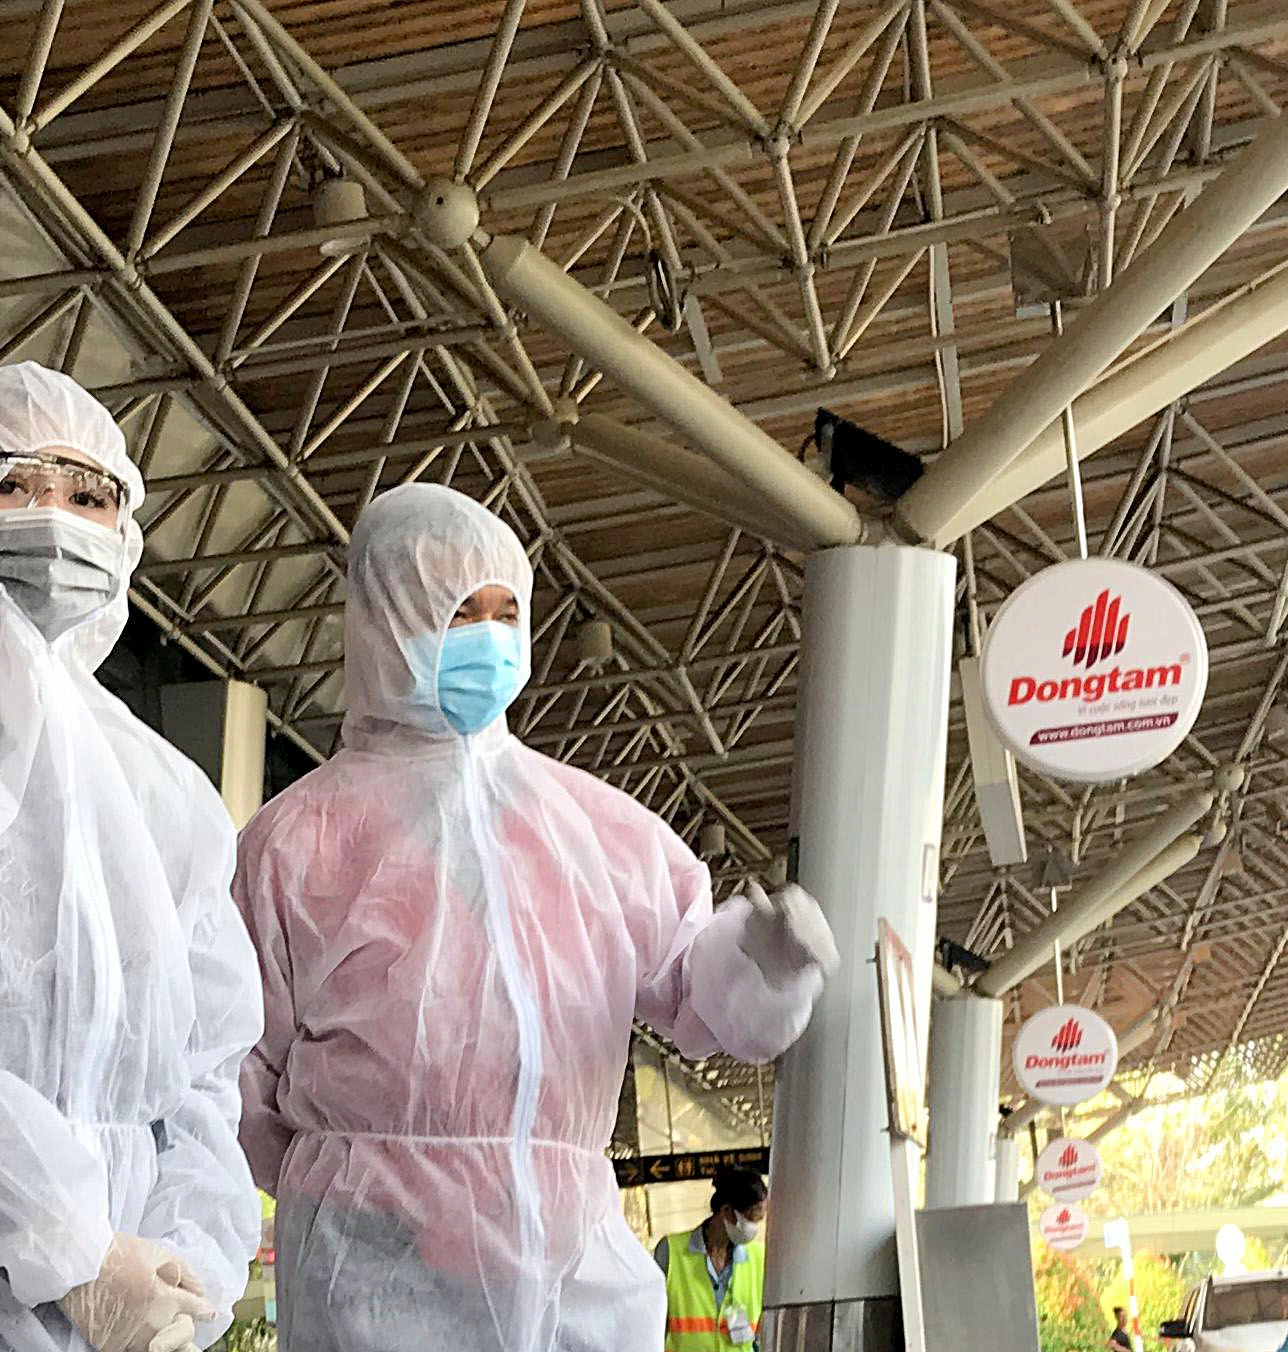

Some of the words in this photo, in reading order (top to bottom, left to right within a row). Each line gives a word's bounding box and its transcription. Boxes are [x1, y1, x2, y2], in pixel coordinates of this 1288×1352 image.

[1007, 663, 1182, 706] Dongtam
[1037, 715, 1171, 743] www.dongtam.com.vn
[1024, 1053, 1106, 1072] Dongtam
